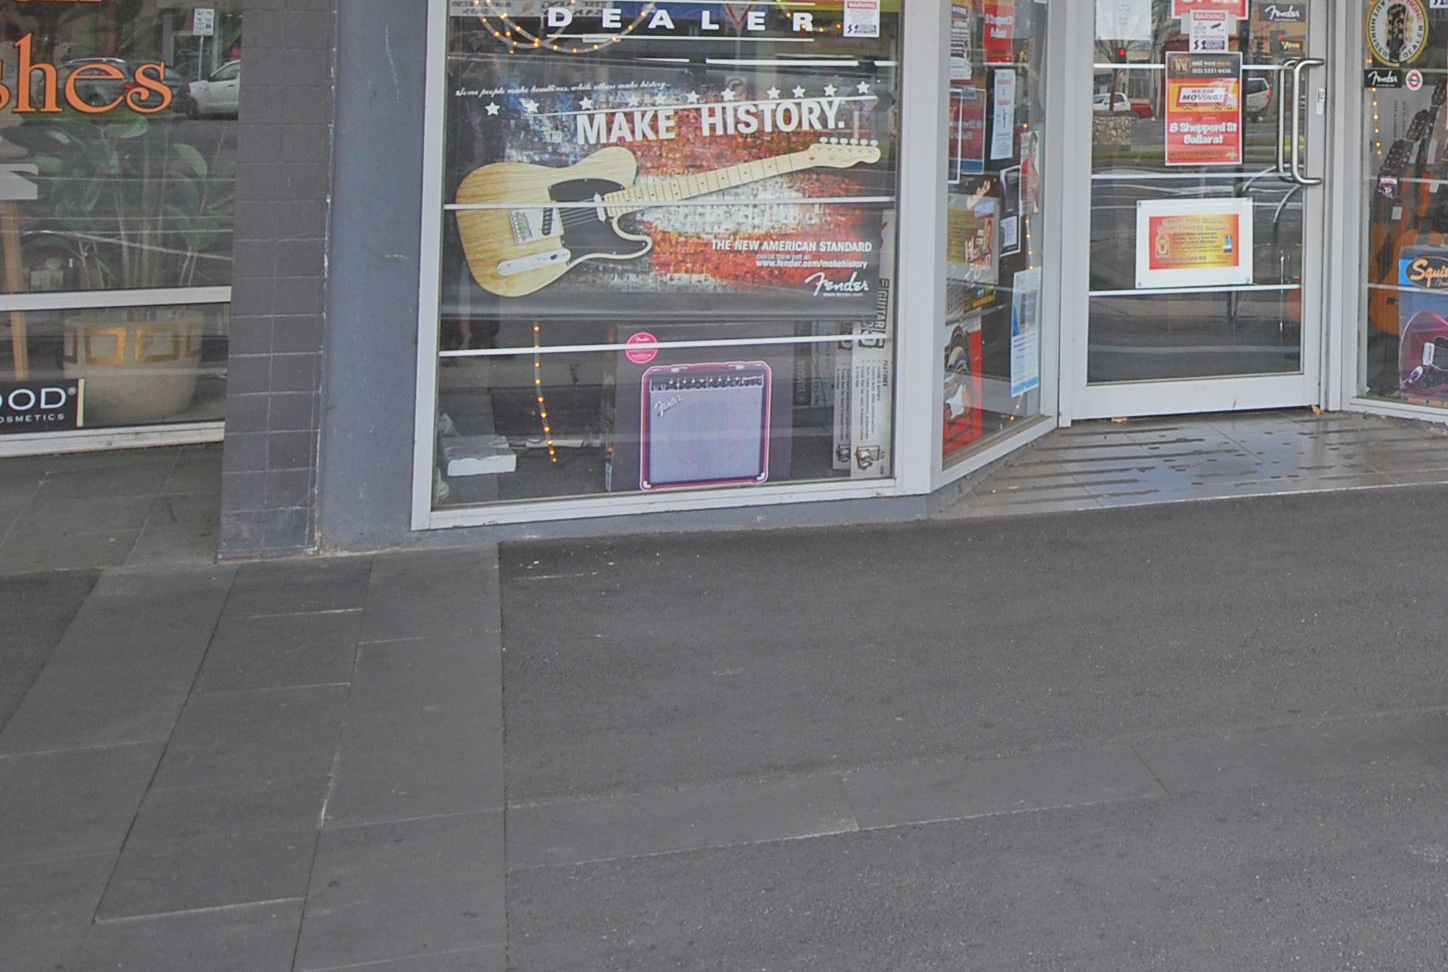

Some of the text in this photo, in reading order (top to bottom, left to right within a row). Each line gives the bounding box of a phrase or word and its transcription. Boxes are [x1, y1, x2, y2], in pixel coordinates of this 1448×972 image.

[548, 8, 813, 32] DEALER
[1264, 5, 1300, 18] Fender
[0, 33, 172, 115] hes
[1368, 71, 1398, 85] Fender
[576, 99, 846, 144] MAKE HISTORY.
[711, 240, 873, 253] THE NEW AMERICAN STANDARD
[804, 271, 870, 297] Fender
[0, 388, 66, 410] OD
